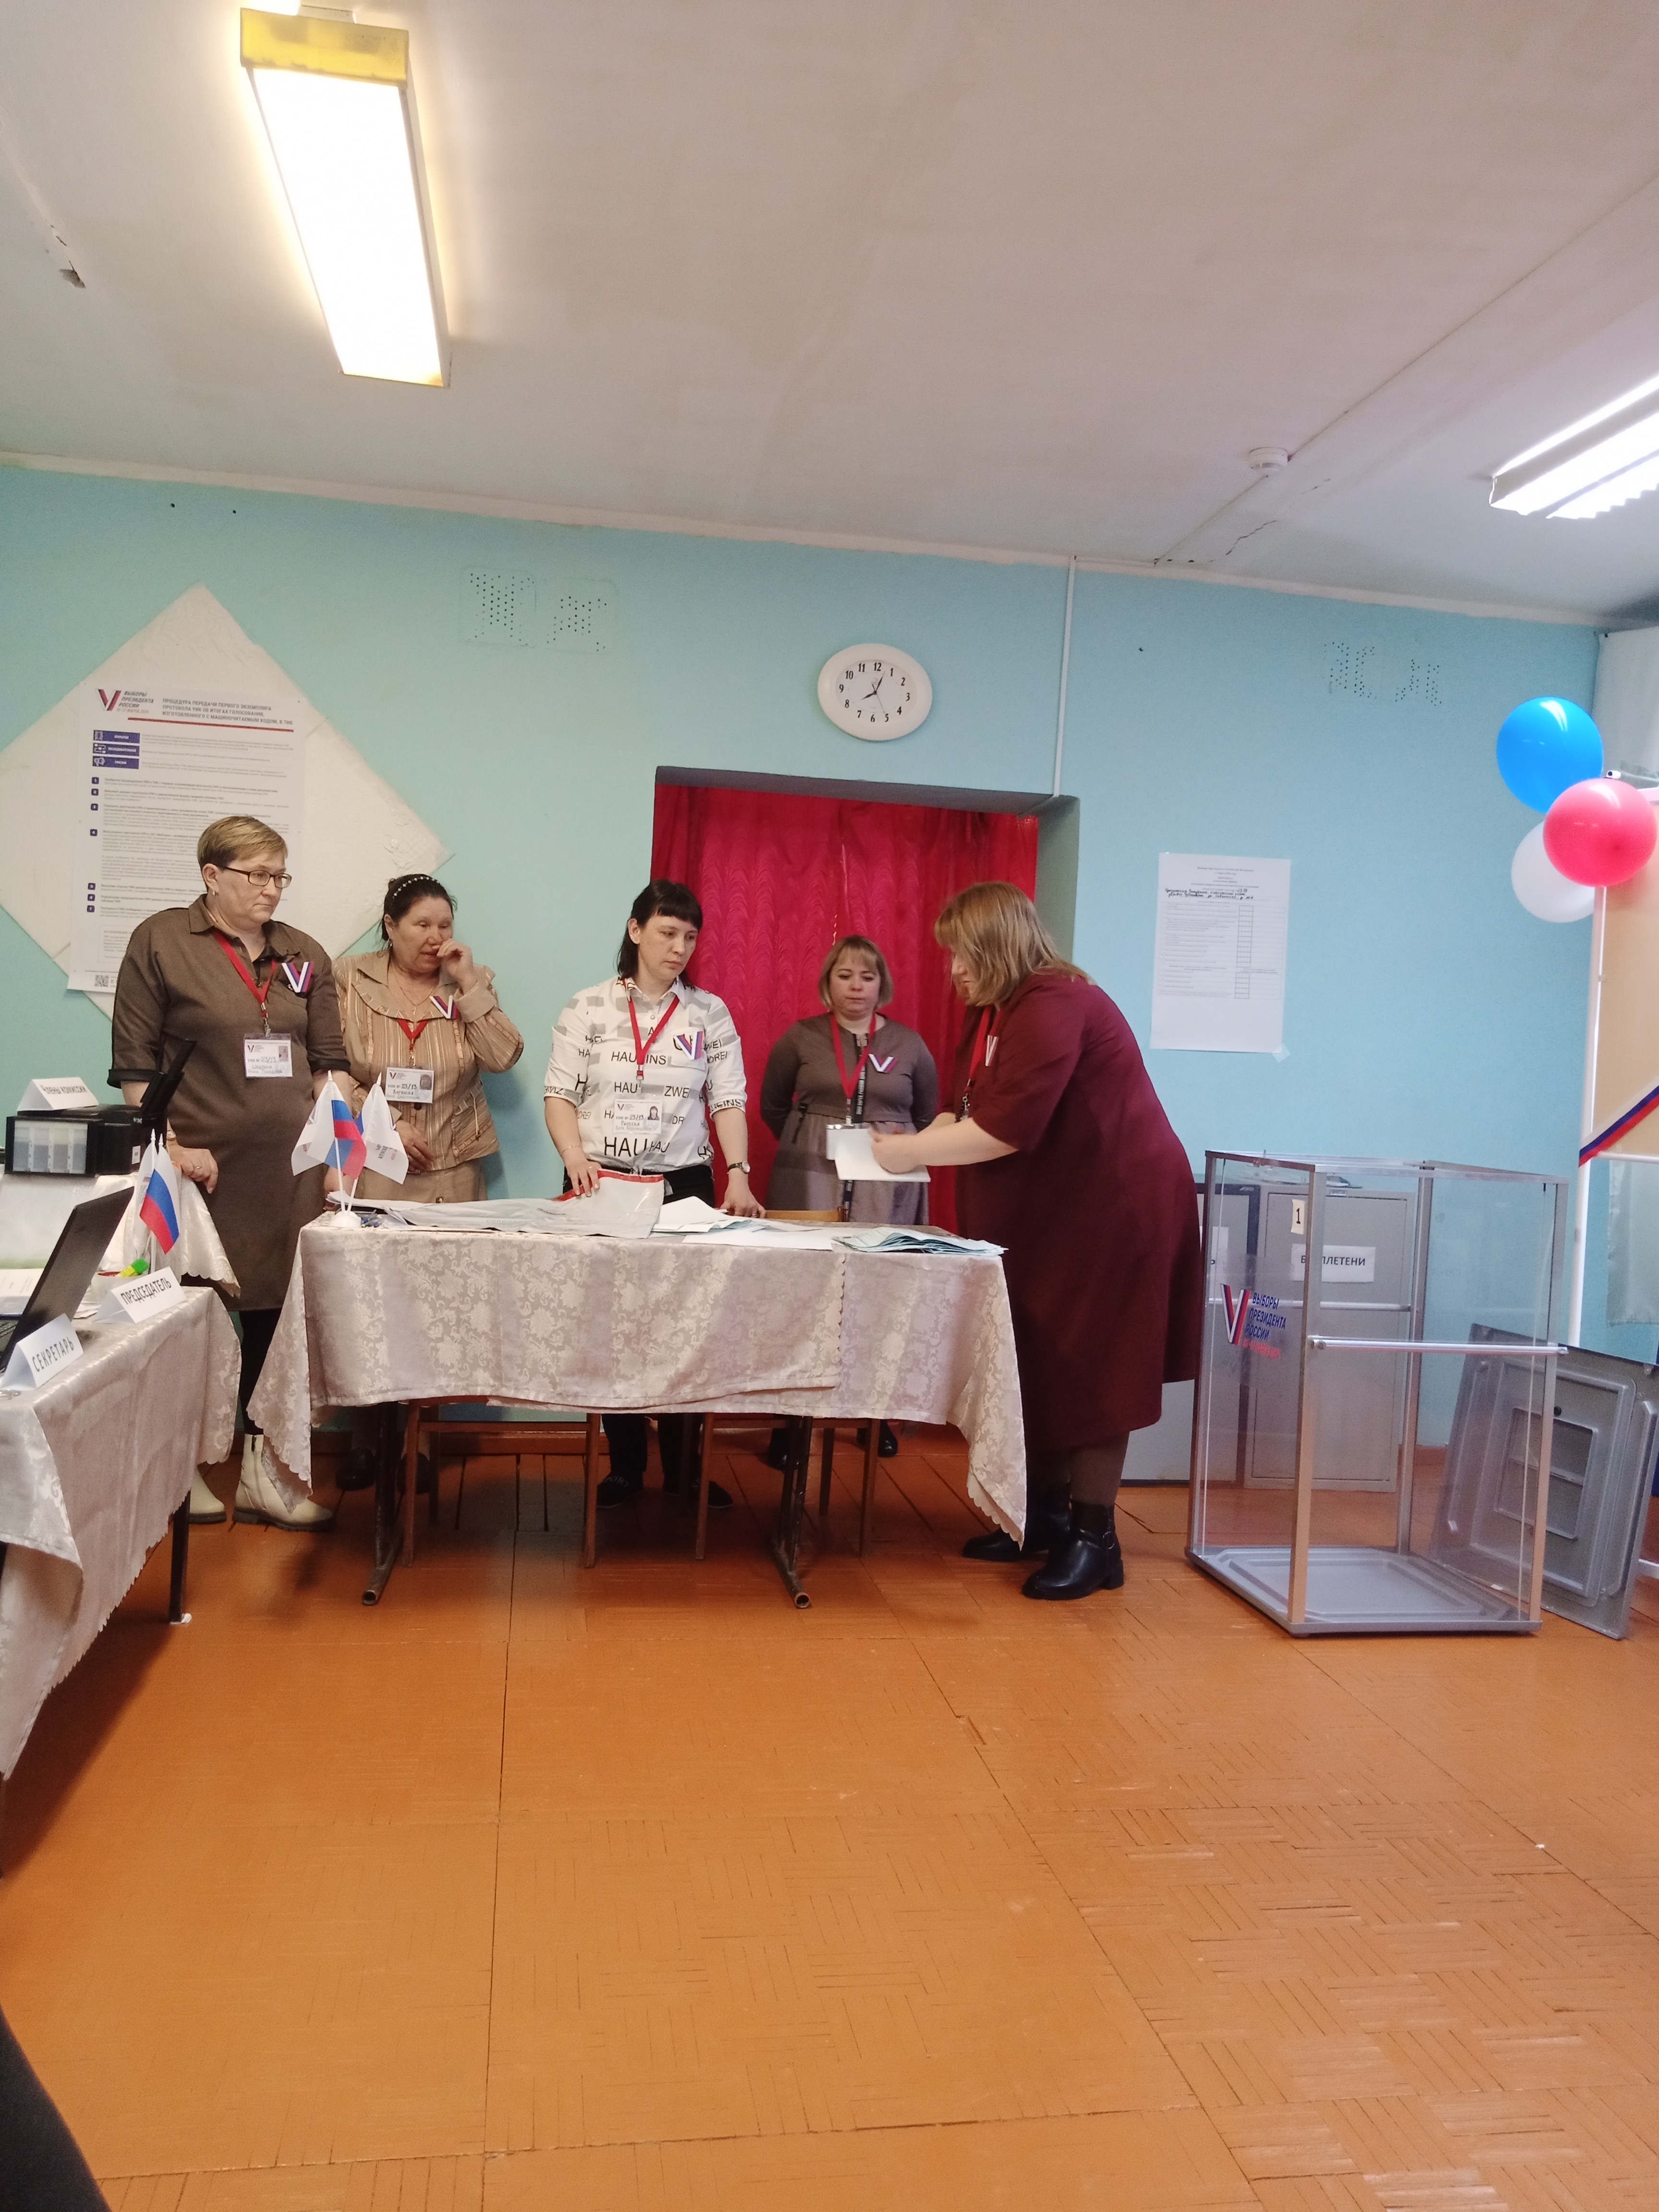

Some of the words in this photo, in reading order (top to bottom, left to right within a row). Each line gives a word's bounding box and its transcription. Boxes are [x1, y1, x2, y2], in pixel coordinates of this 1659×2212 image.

[858, 663, 865, 672] 11
[874, 662, 881, 671] 12
[845, 671, 854, 680] 10
[890, 668, 893, 676] 1
[901, 677, 905, 686] 2
[839, 684, 844, 693] 9
[906, 693, 910, 701] 3
[845, 699, 849, 708] 8
[857, 710, 862, 718] 7
[897, 706, 902, 715] 4
[885, 713, 889, 722] 5
[646, 1055, 666, 1065] INS
[614, 1082, 637, 1094] HAU
[664, 1085, 692, 1099] ZWEI
[604, 1136, 648, 1157] HAU
[649, 1141, 670, 1153] HAU
[1296, 1208, 1301, 1224] 1
[1301, 1255, 1366, 1266] БЛЕТЕНИ
[120, 1277, 172, 1305] ПРЕДСЕДАТЕЛЬ
[1252, 1292, 1280, 1310] ВЫБОРЫ
[1249, 1308, 1286, 1330] ПРЕЗИДЕНТА
[1246, 1323, 1270, 1341] РОССИИ
[32, 1336, 75, 1373] СЕКРЕТАРЬ
